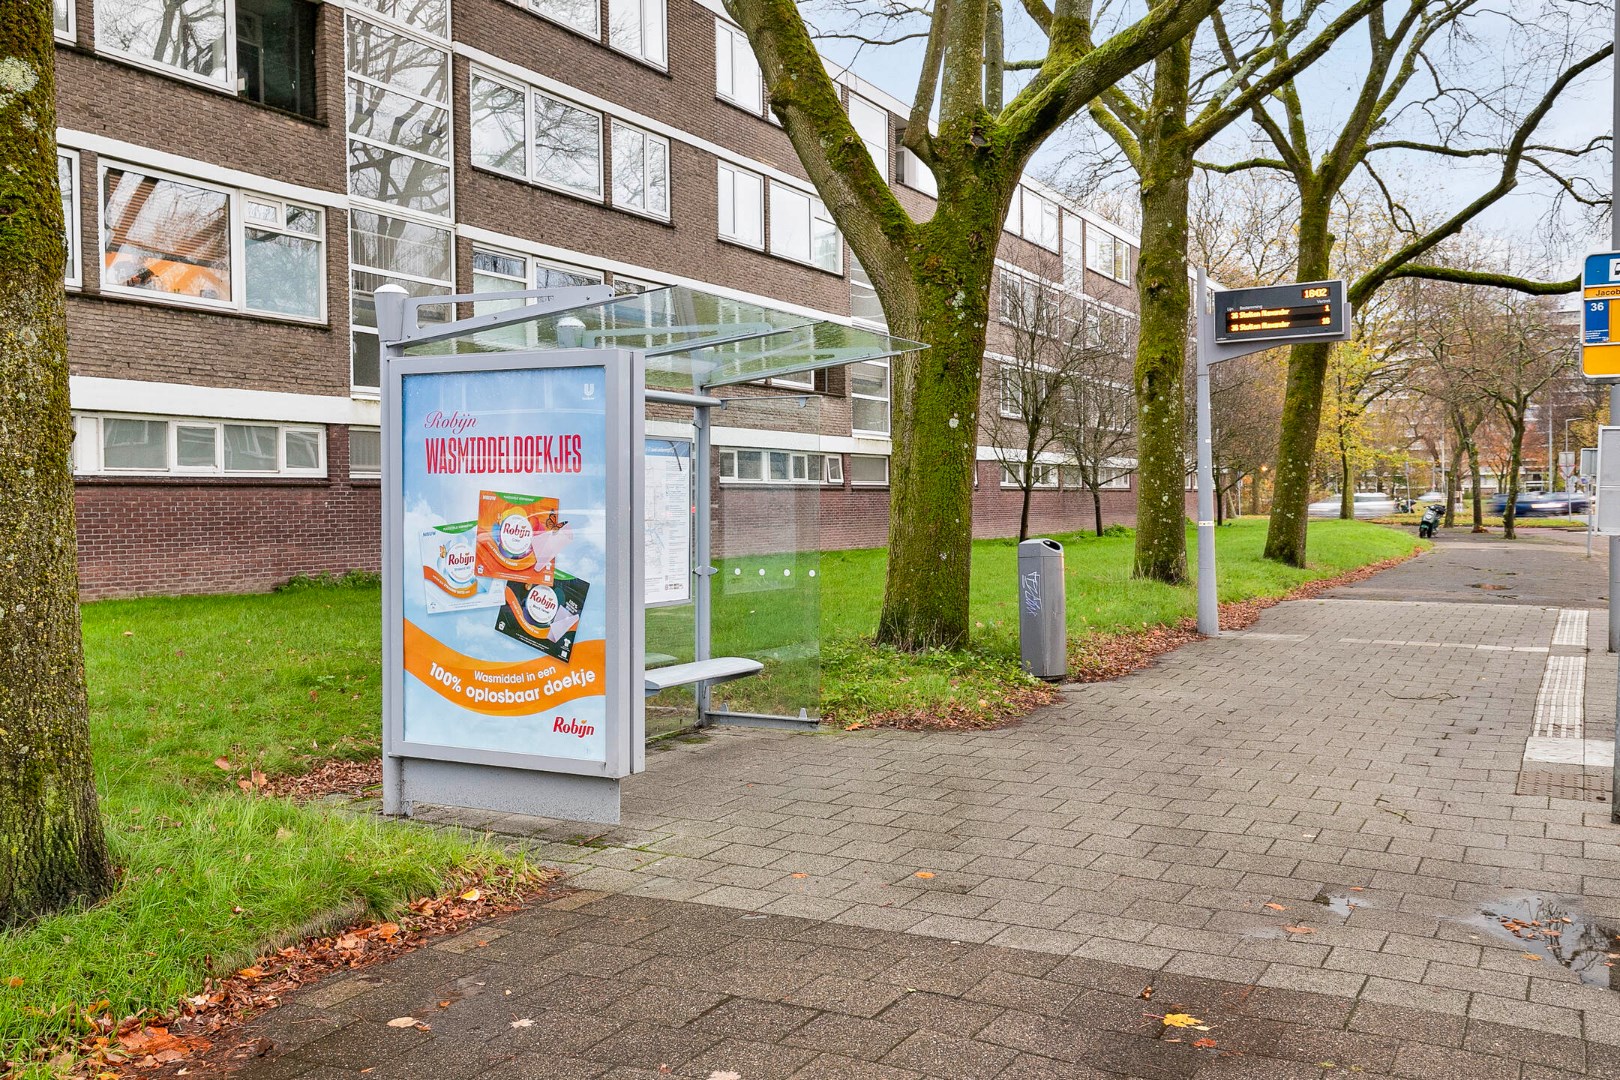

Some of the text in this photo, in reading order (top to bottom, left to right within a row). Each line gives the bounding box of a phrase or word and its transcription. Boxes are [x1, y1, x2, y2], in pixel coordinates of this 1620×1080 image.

[1590, 302, 1605, 312] 36
[424, 410, 479, 434] Robijn
[425, 434, 582, 474] WASMIDDELDOEKJES
[503, 522, 531, 539] Robijn
[448, 552, 475, 566] Robijn
[529, 589, 556, 610] Robijn
[429, 661, 597, 704] 100% oplosbaar doekje
[474, 665, 557, 684] Wasmiddel in een
[552, 716, 596, 739] Robijn
